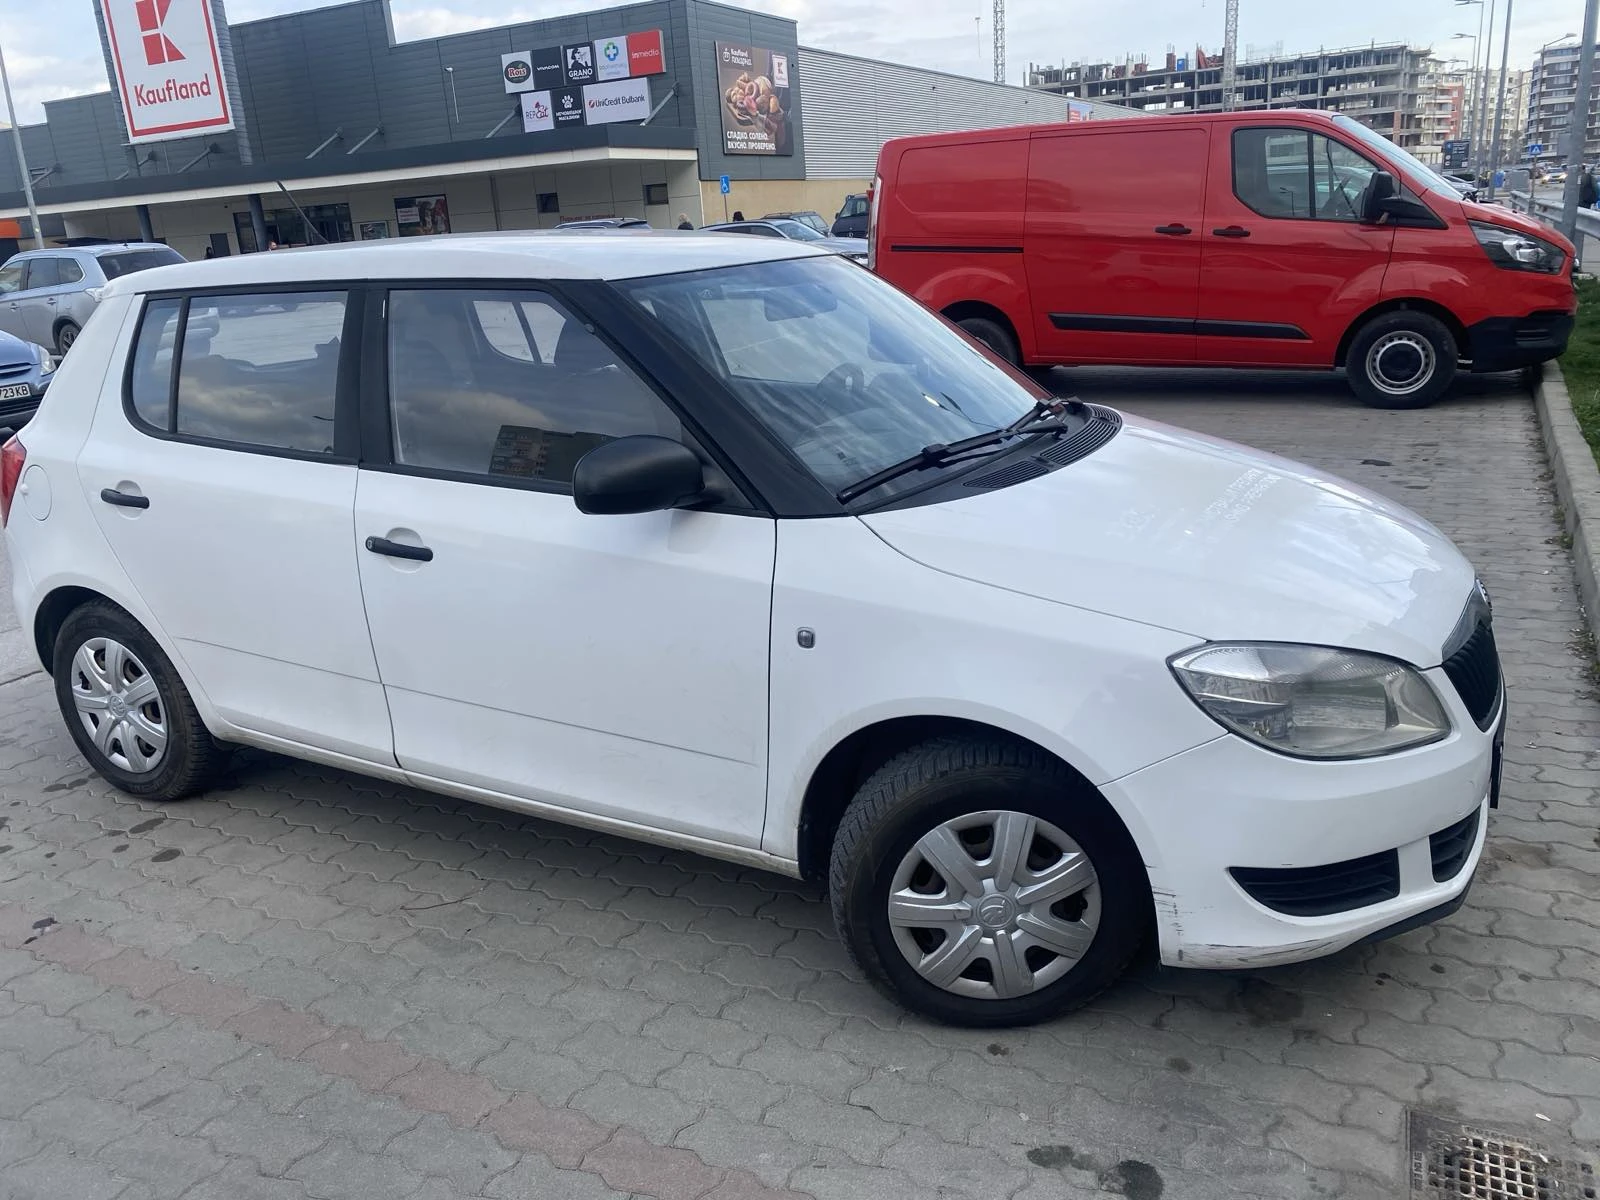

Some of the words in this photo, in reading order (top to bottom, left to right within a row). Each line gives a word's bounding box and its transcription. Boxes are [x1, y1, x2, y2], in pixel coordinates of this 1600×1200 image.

[730, 48, 749, 58] Kaufland
[568, 68, 593, 78] GRANO
[133, 73, 212, 107] Kaufland
[595, 96, 621, 108] UniCredit
[621, 94, 646, 105] Bulbank
[727, 140, 747, 150] ВКУСНО.
[747, 141, 777, 151] ПРОВЕРЕНО.
